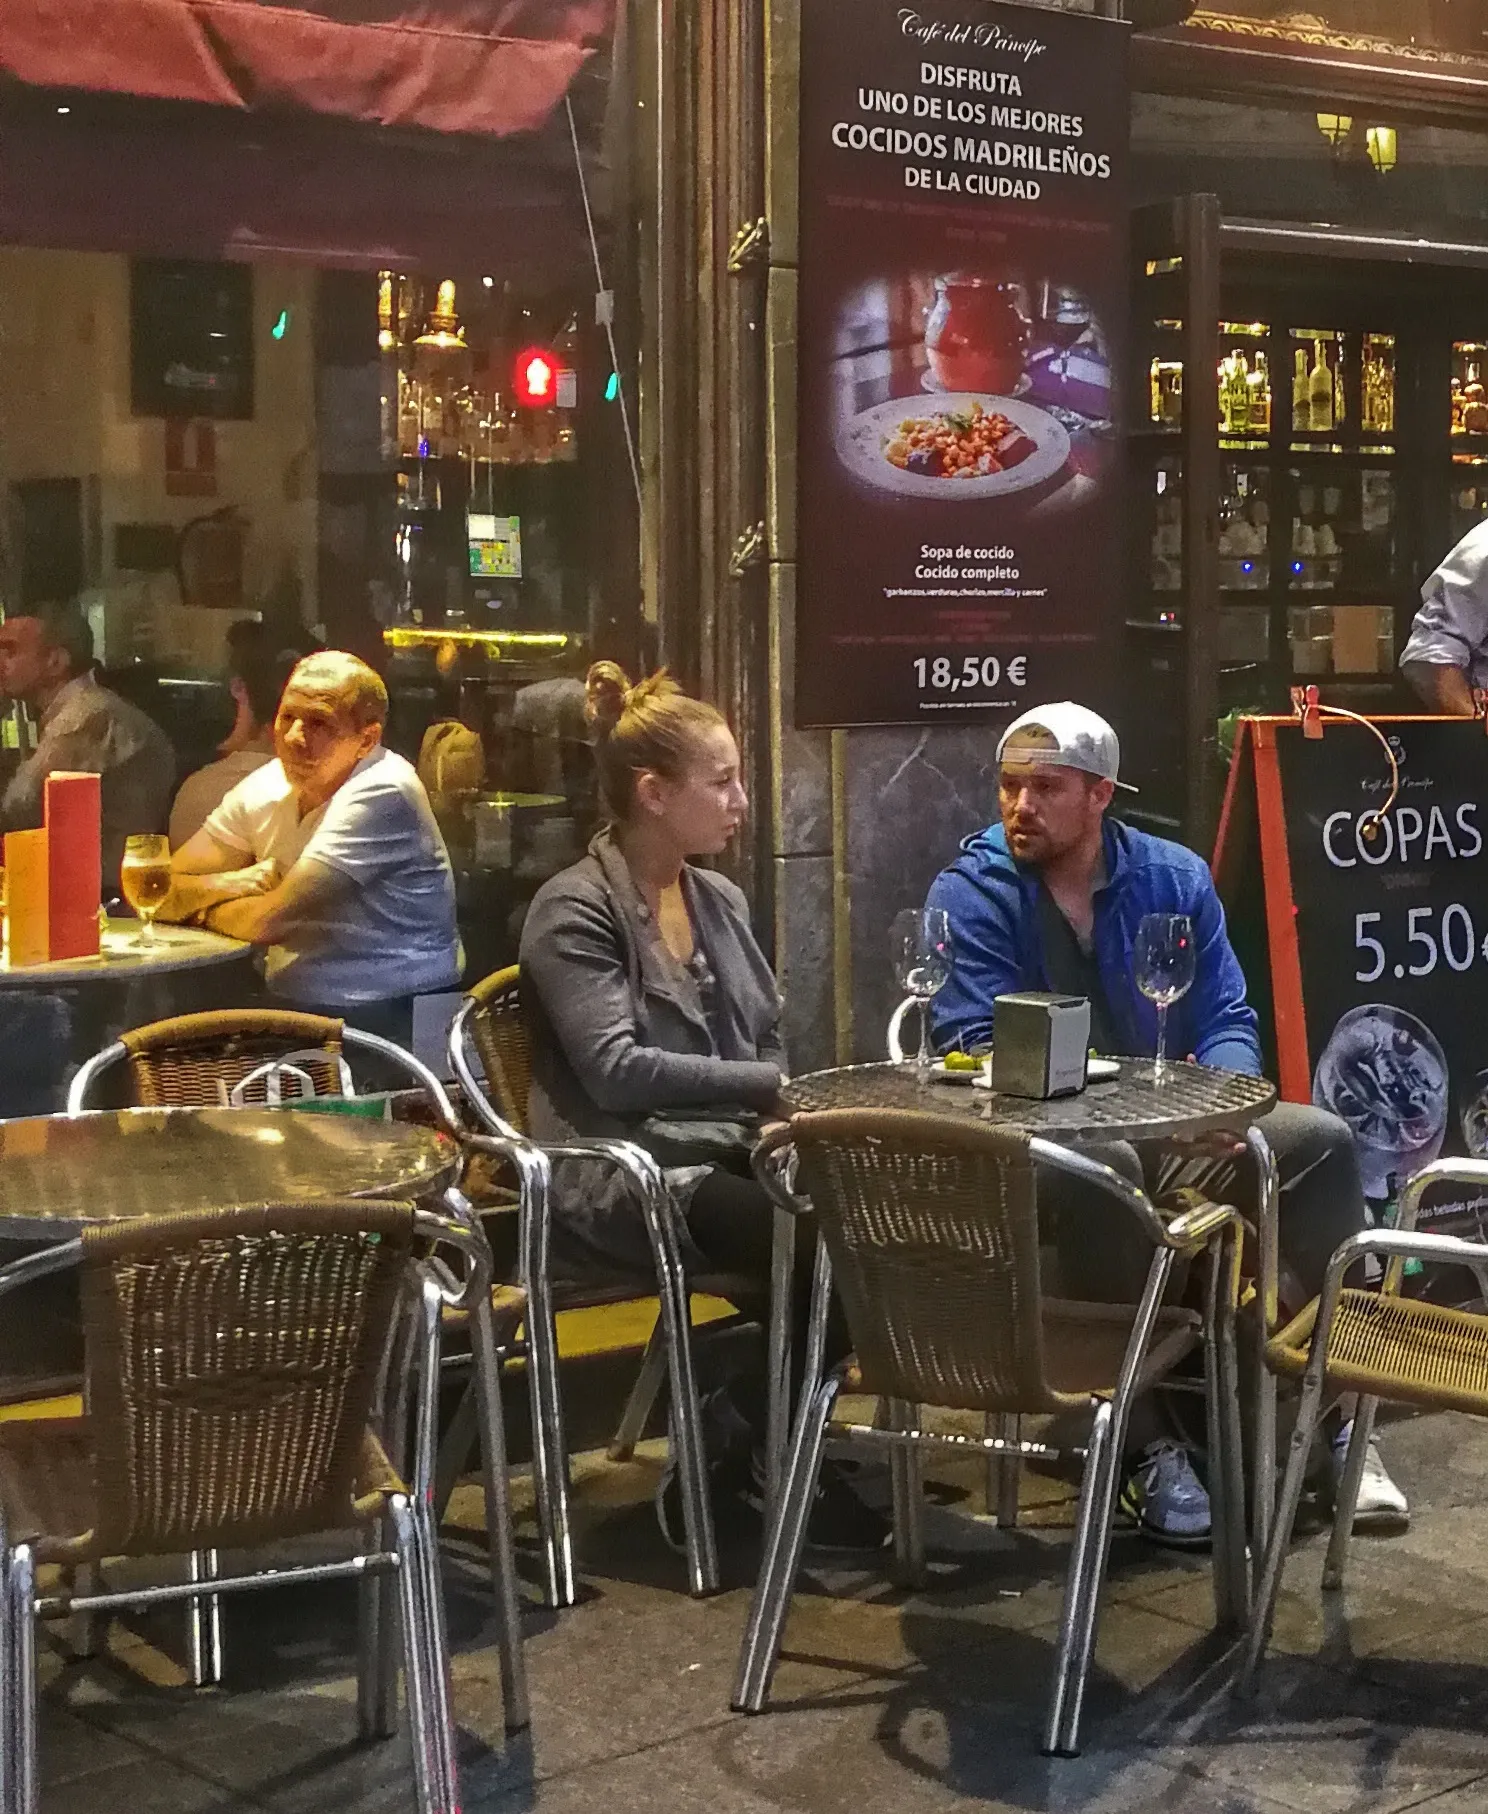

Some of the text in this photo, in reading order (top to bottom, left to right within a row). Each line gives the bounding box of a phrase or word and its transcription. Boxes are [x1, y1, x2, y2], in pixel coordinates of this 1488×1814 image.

[897, 8, 943, 45] Café
[944, 24, 968, 44] del
[920, 61, 1022, 97] DISFRUTA
[859, 88, 1083, 138] UNO DE LOS MEJORES
[832, 122, 1111, 179] COCIDOS MADRILEÑOS
[905, 166, 1040, 201] DE LA CIUDAD
[920, 544, 1015, 561] Sopa de cocido
[915, 564, 1020, 582] Cocido completo
[913, 656, 1027, 692] 18,50 €
[1322, 803, 1483, 868] COPAS
